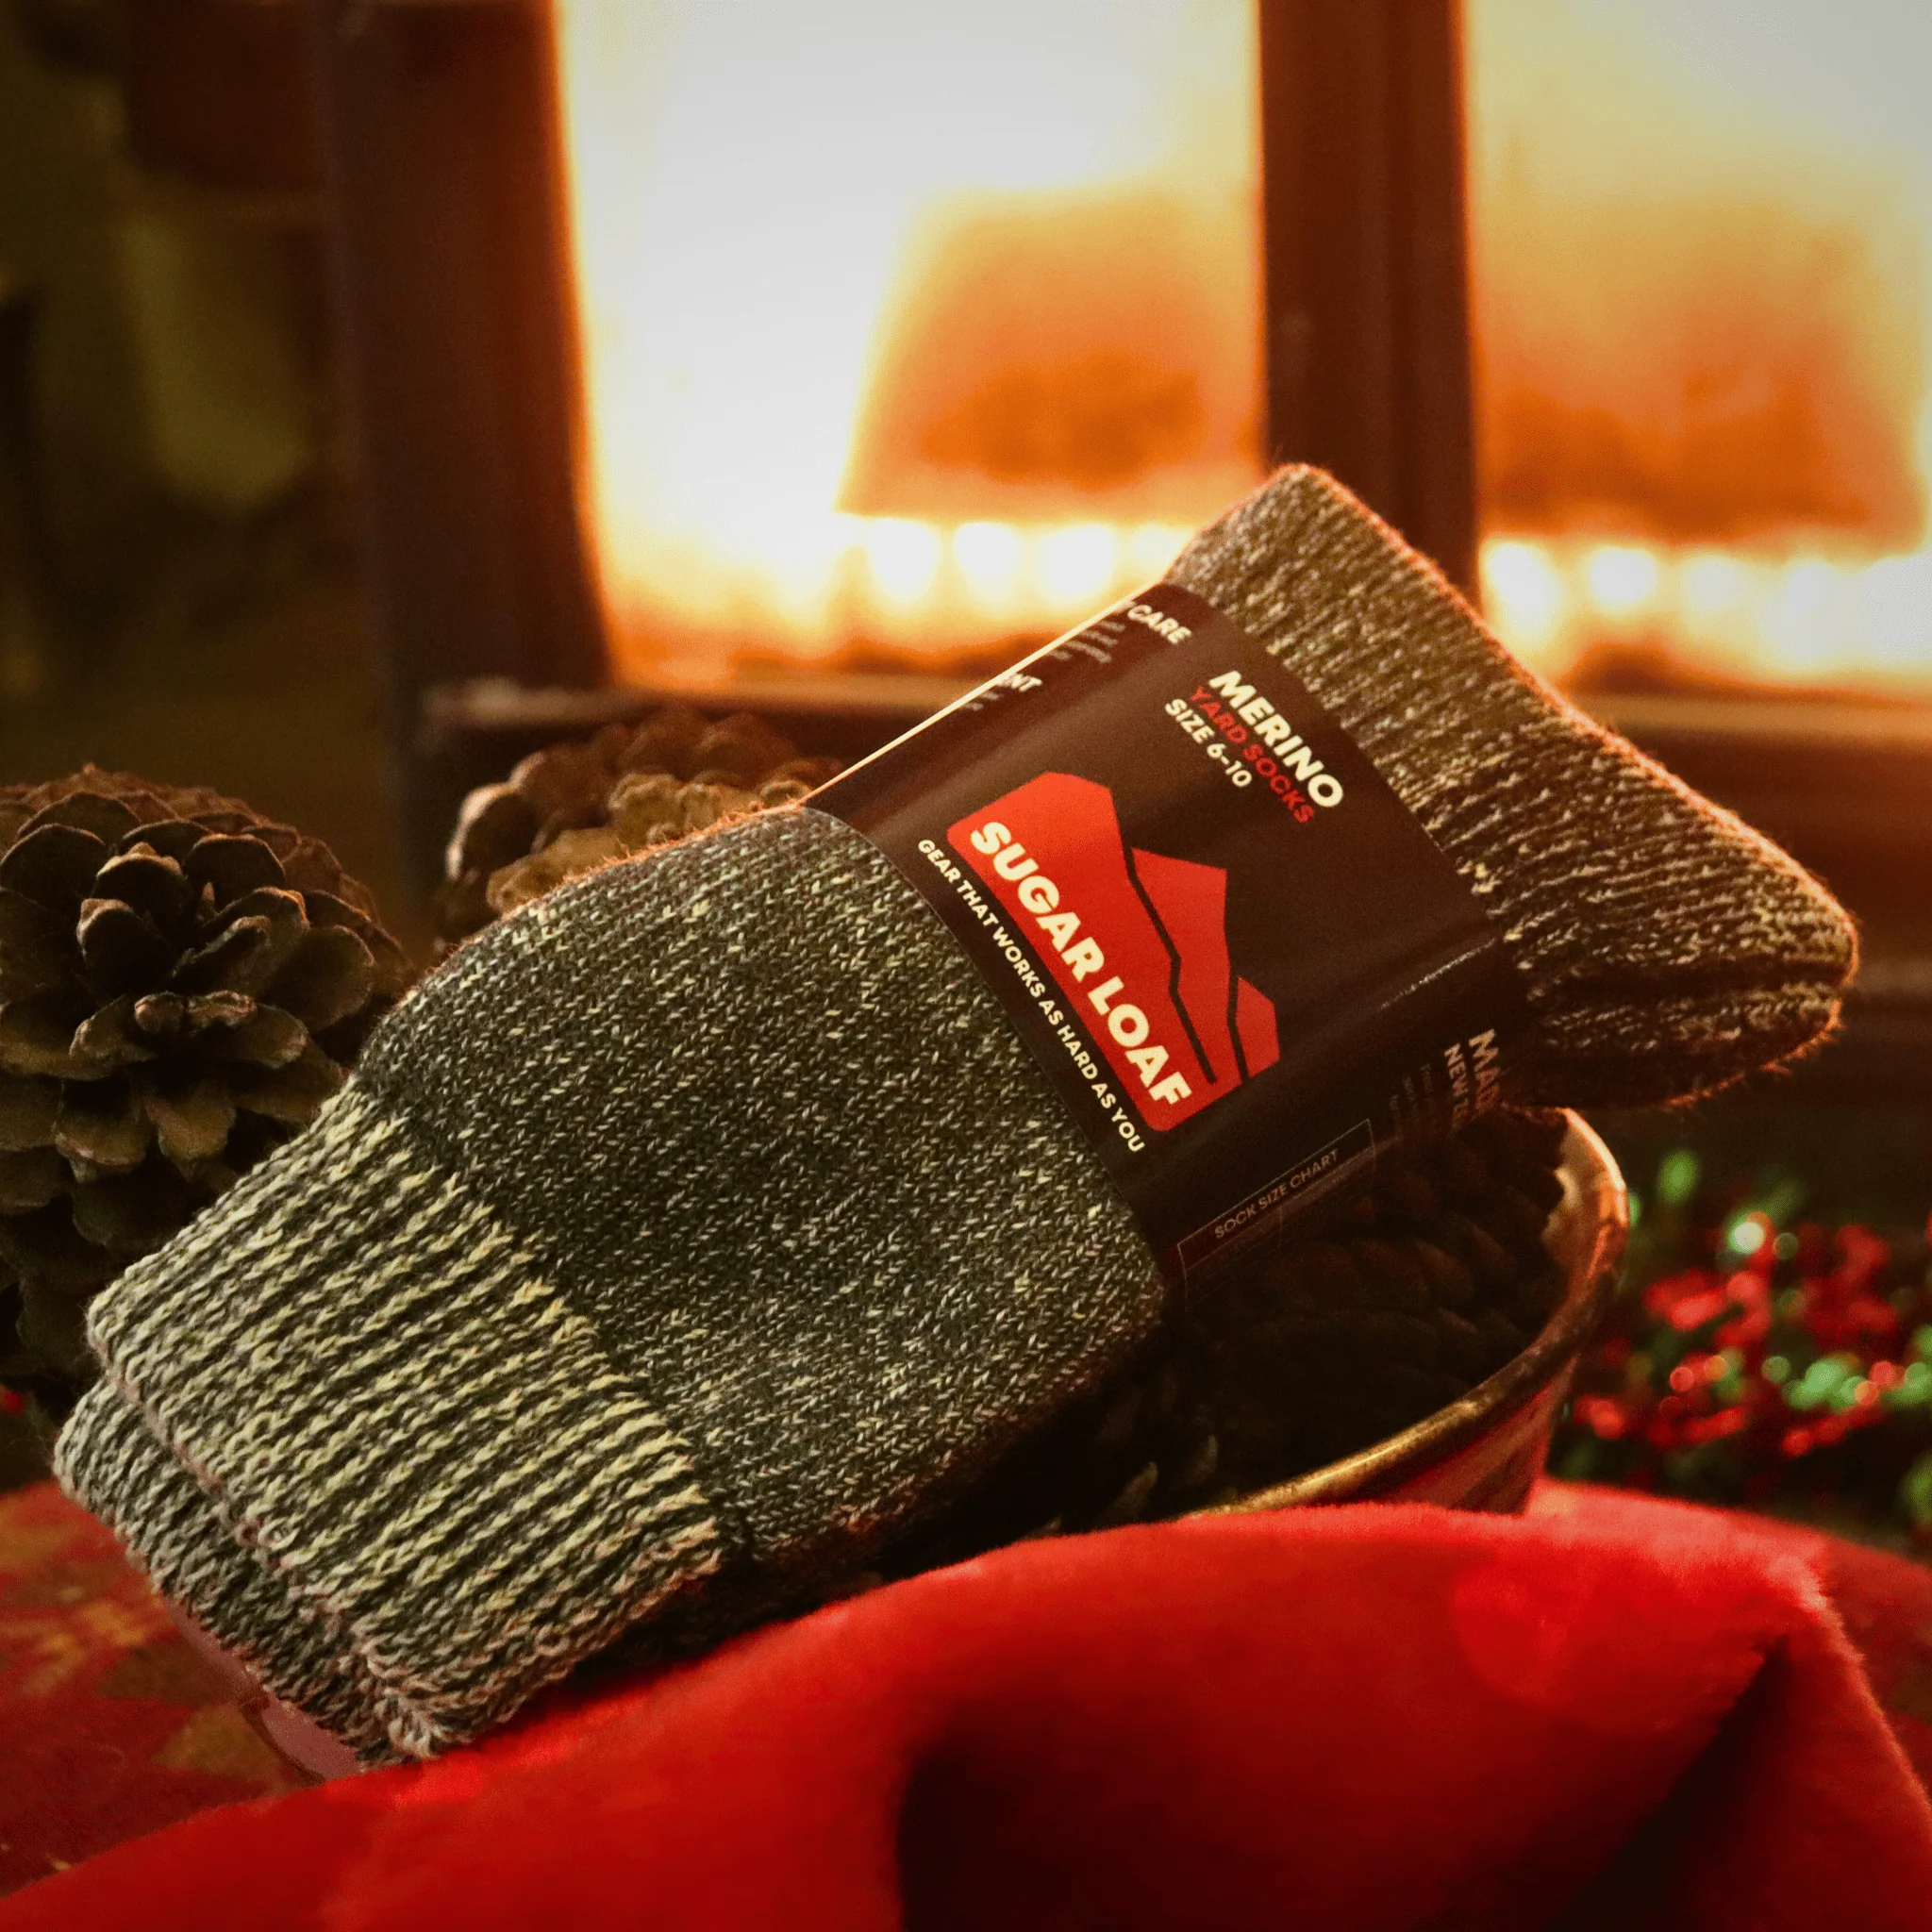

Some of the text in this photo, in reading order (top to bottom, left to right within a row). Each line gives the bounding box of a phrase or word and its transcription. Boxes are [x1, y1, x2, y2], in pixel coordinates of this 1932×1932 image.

[1127, 604, 1192, 645] CARE
[1165, 698, 1252, 788] SIZE 6-10
[1191, 686, 1314, 823] YARD SOCKS
[1208, 671, 1343, 808] MERINO
[918, 840, 1145, 1152] GEAR THAT WORKS AS HARD AS YOU
[971, 822, 1192, 1105] SUGAR LOAF
[1443, 1042, 1469, 1097] NEW
[1214, 1147, 1339, 1240] SOCK SIZE CHART
